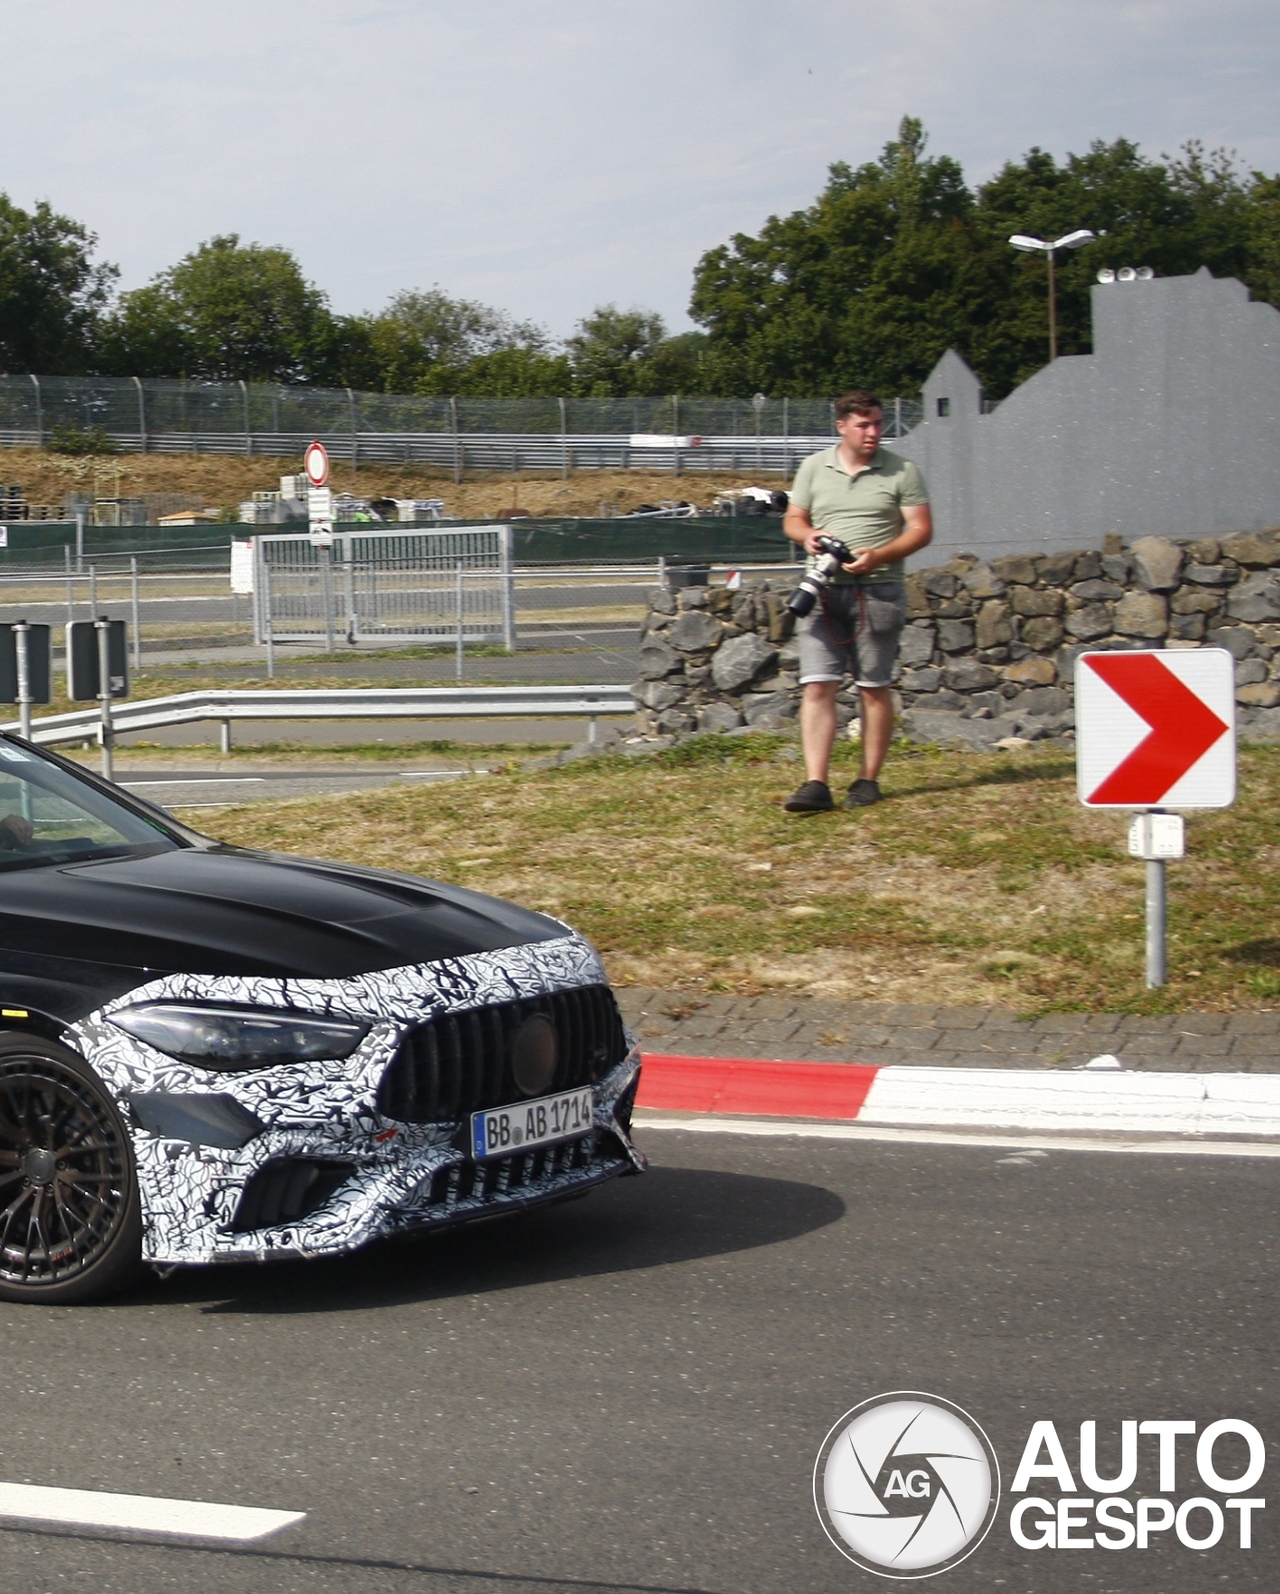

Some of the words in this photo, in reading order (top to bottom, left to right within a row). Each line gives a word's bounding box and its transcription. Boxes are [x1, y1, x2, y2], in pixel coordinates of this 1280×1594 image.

[486, 1113, 510, 1150] BB
[525, 1105, 547, 1141] AB
[551, 1094, 590, 1132] 1714
